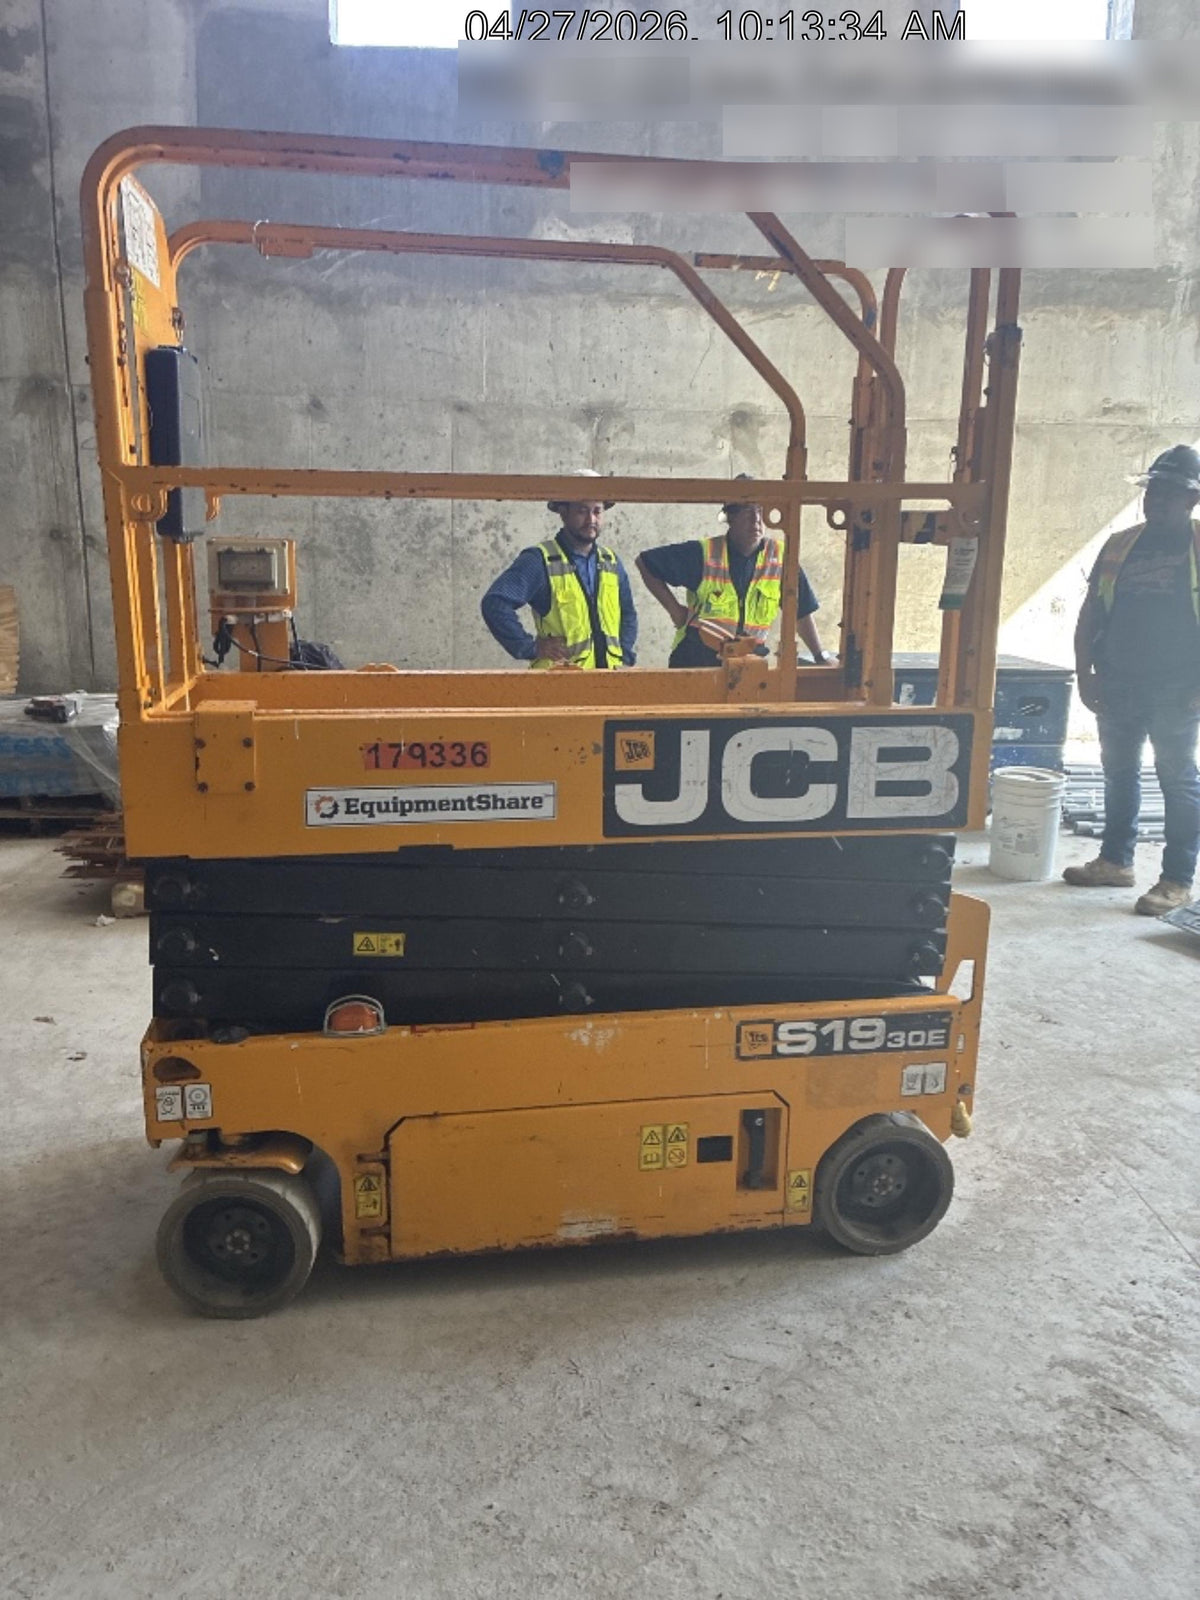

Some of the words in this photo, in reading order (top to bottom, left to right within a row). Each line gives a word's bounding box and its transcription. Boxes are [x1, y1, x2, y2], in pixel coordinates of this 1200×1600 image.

[367, 742, 489, 768] 179336
[615, 726, 960, 826] JCB
[344, 794, 544, 818] EquipmentShare
